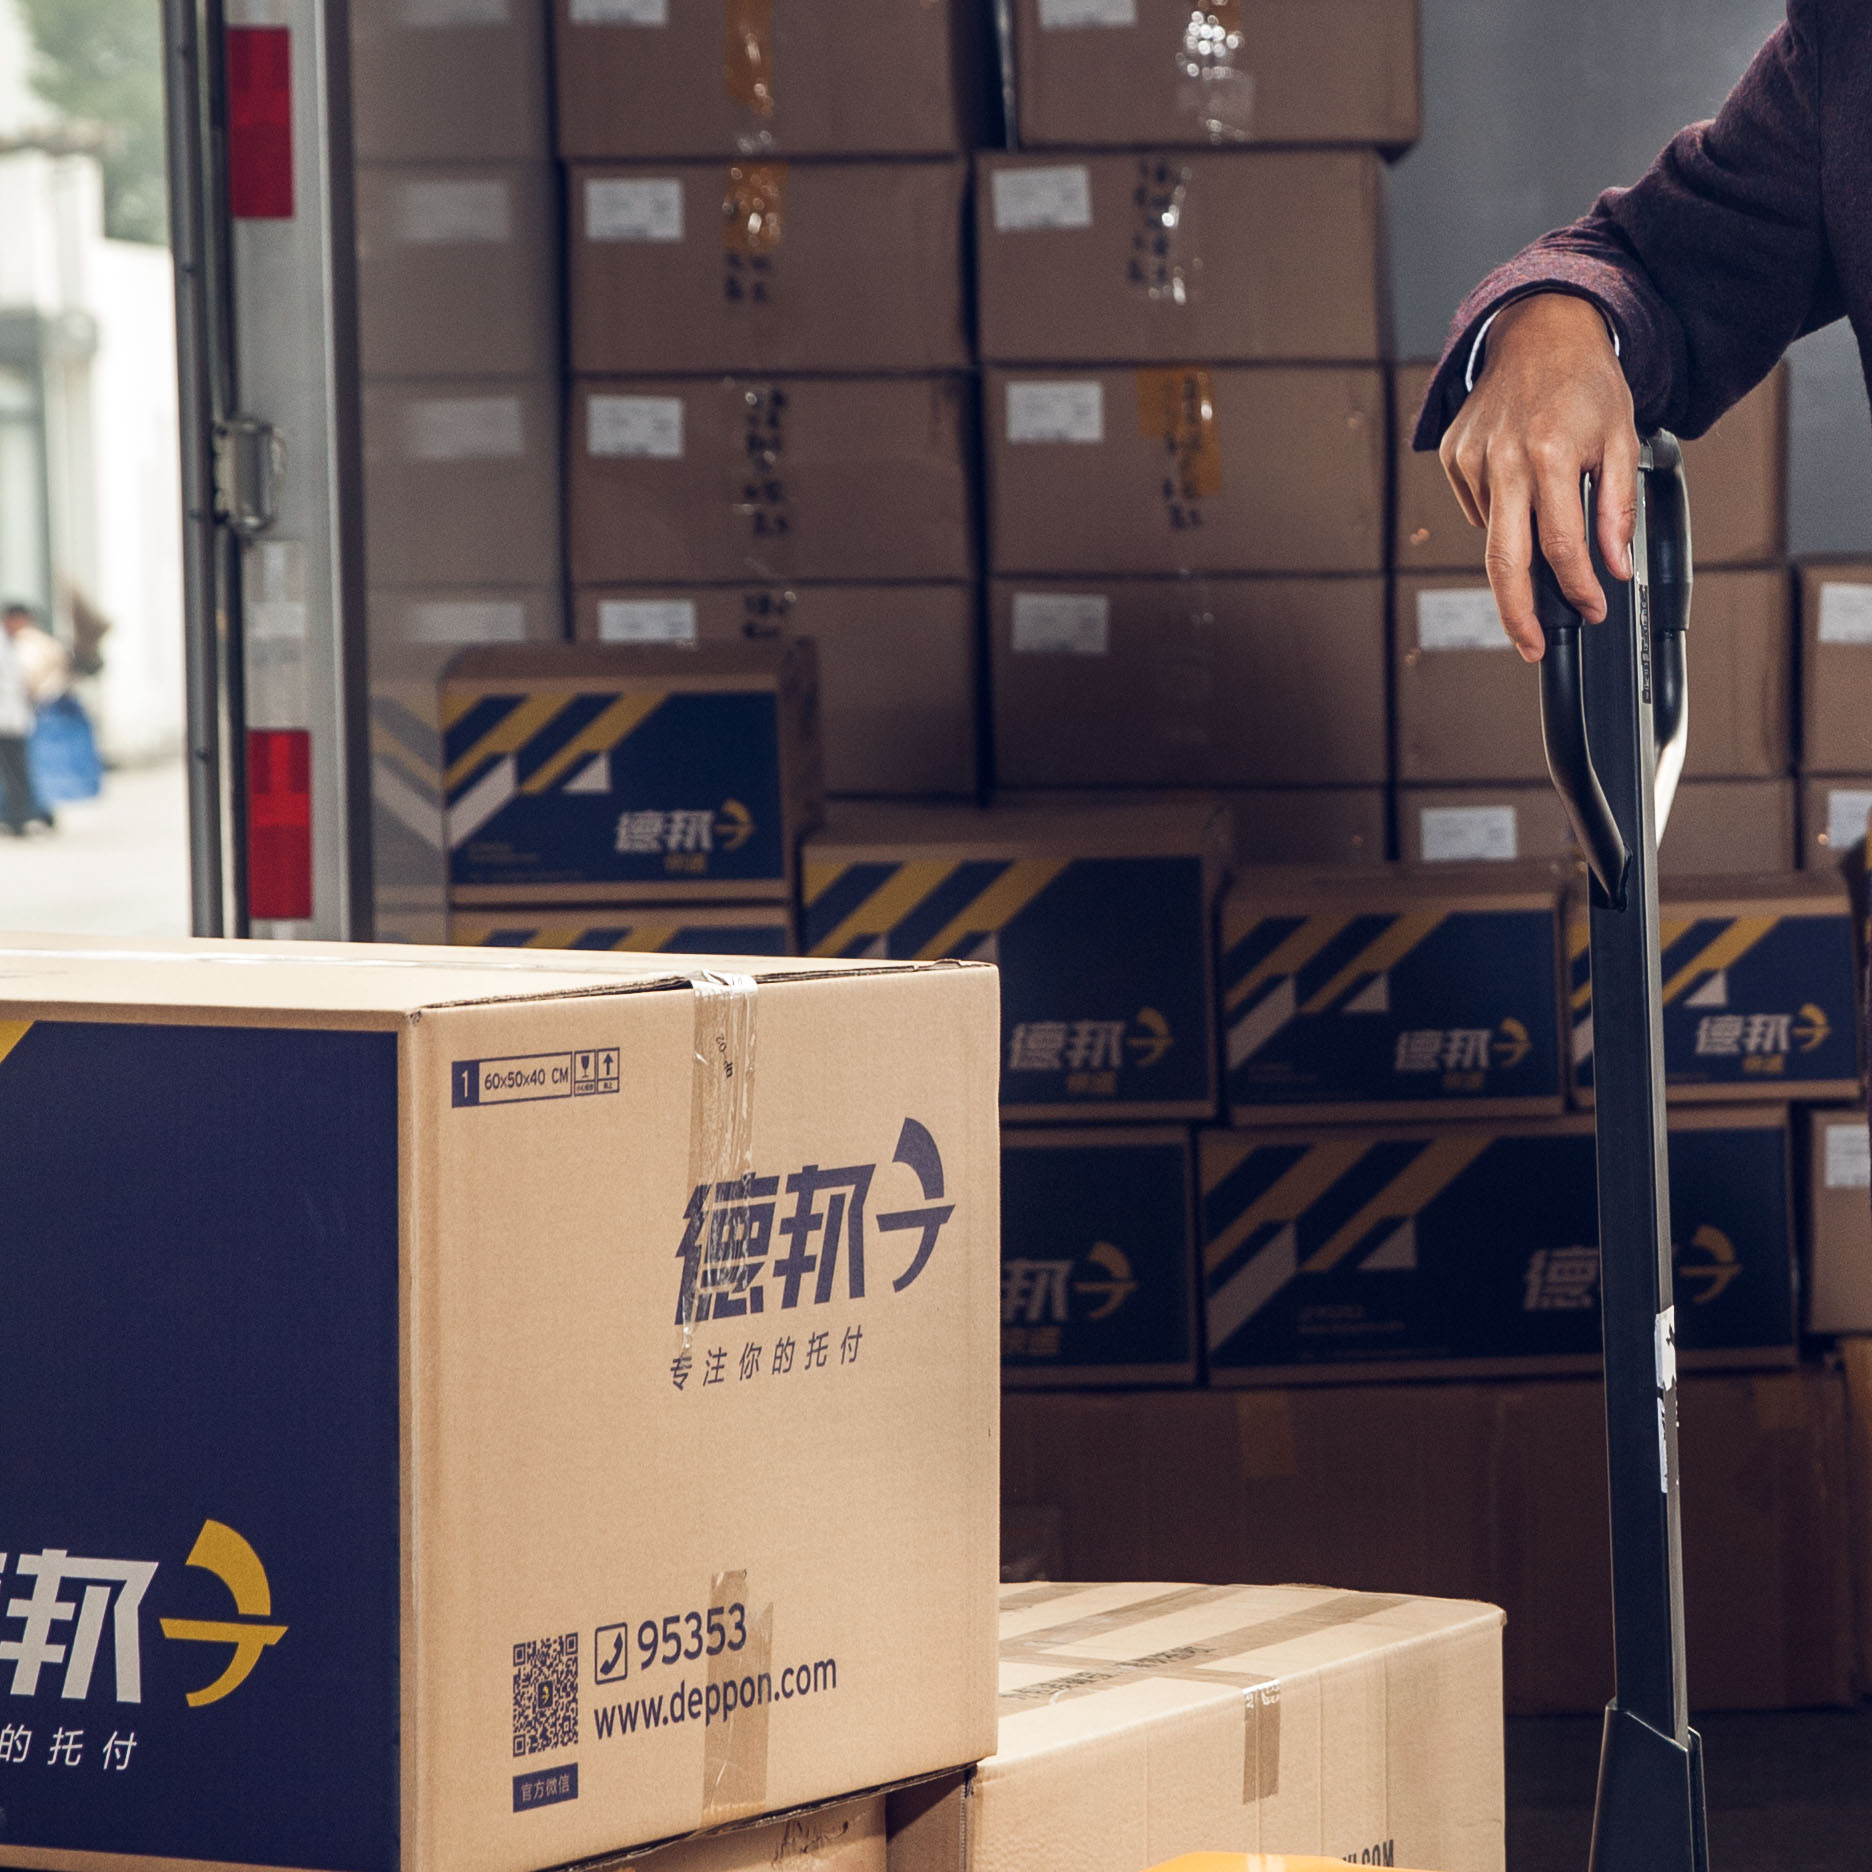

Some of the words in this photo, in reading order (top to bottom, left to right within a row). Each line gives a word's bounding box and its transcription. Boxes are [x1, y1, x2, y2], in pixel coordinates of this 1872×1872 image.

[461, 1069, 469, 1099] 1
[484, 1068, 546, 1091] 60x50x40
[551, 1066, 569, 1085] CM
[674, 1164, 877, 1326] 德邦
[669, 1324, 863, 1391] 专注你的托付
[0, 1548, 159, 1705] 邦
[637, 1602, 748, 1671] 95353
[593, 1657, 837, 1740] www.deppon.com
[520, 1773, 570, 1802] 官方微信
